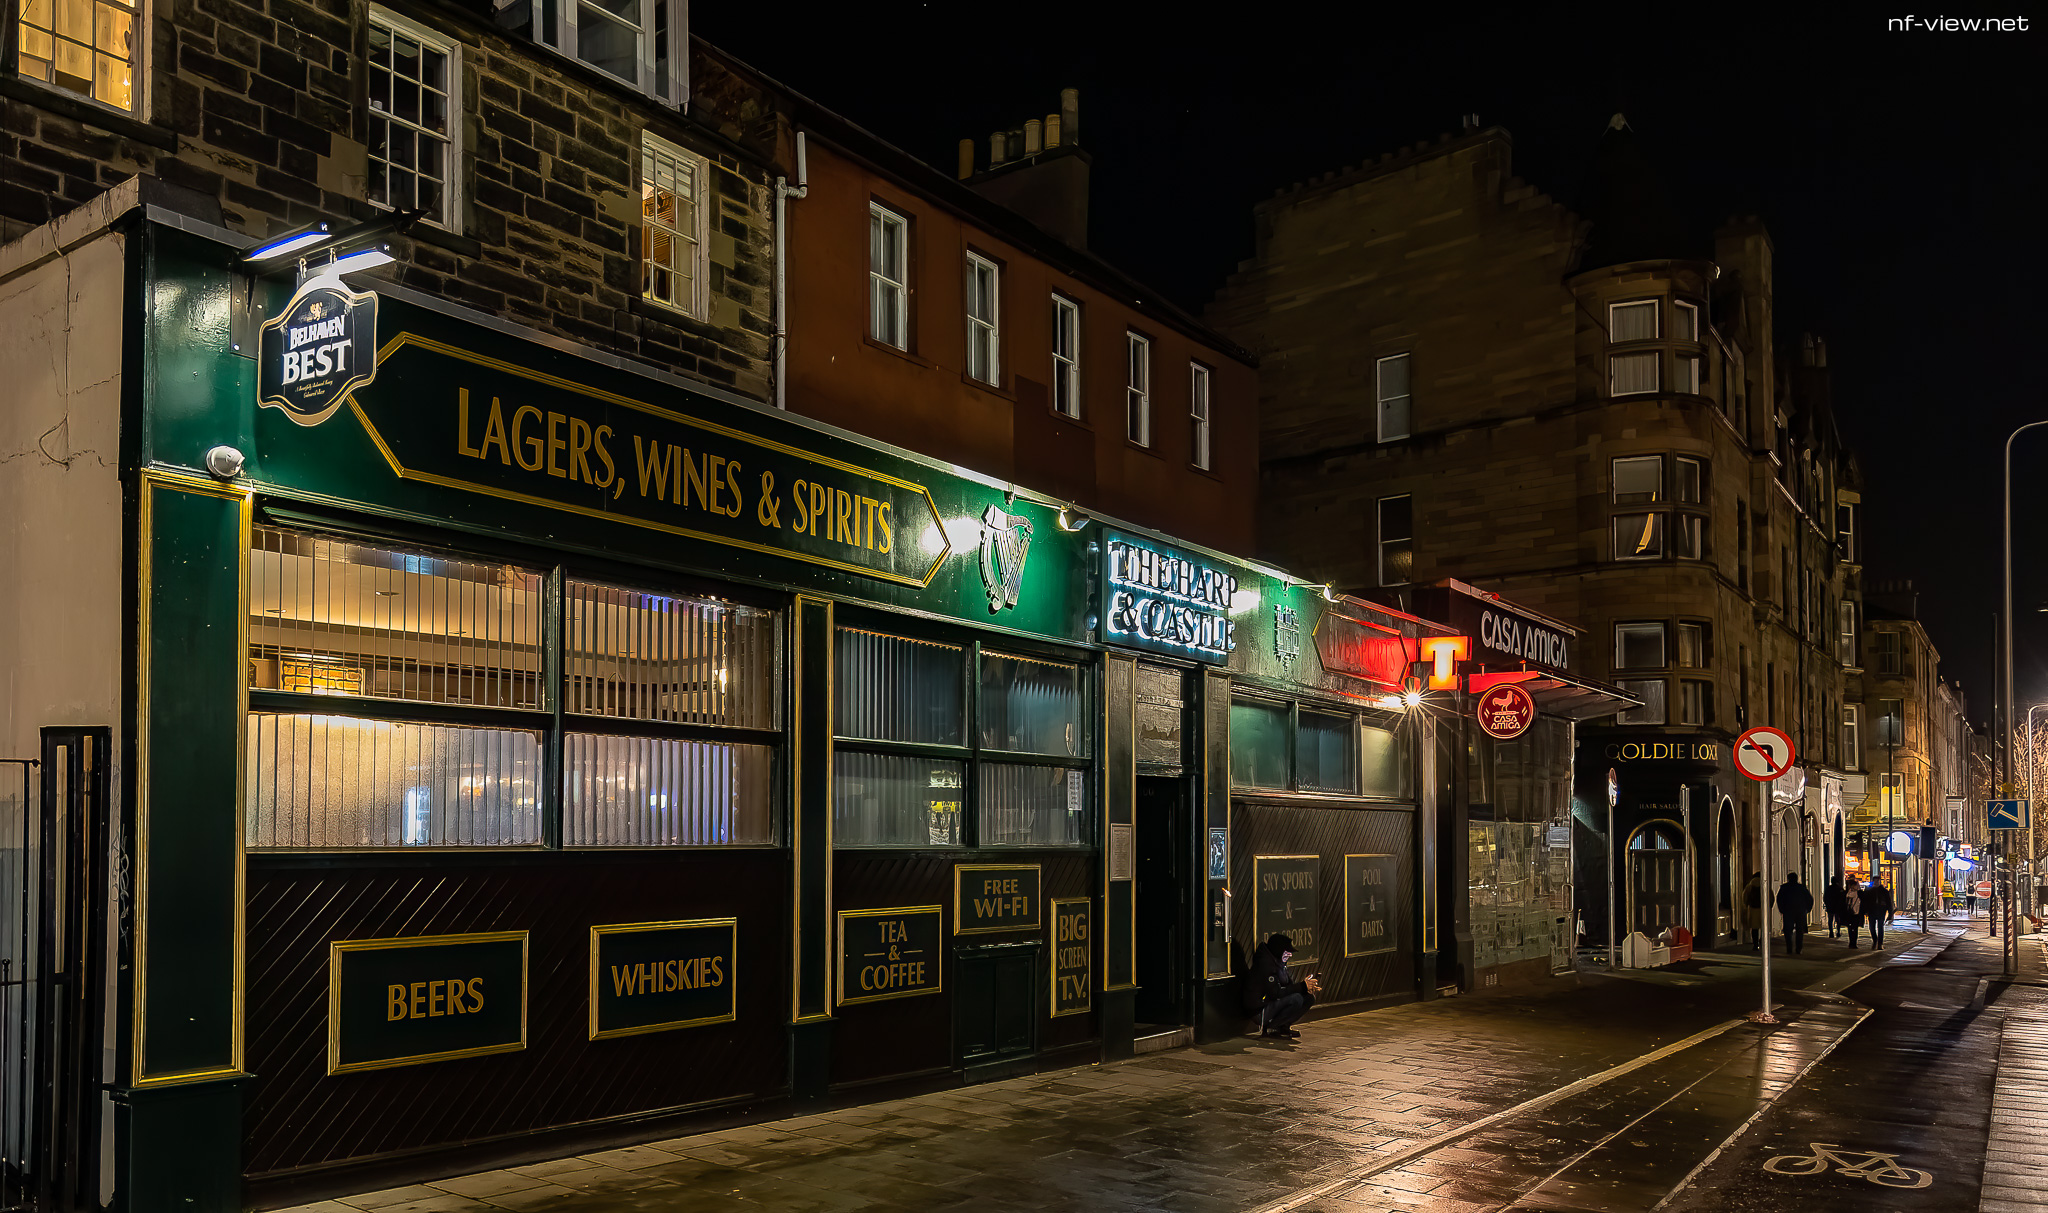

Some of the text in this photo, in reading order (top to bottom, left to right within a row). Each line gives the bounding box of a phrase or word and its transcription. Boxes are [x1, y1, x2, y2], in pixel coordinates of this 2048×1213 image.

[290, 315, 345, 350] BELHAVEN
[282, 339, 352, 385] BEST
[458, 387, 892, 554] LAGERS, WINES & SPIRITS
[1107, 541, 1238, 608] THE HARP
[1108, 592, 1236, 654] & CASTLE
[1481, 610, 1568, 669] CASA AMIGA
[1491, 721, 1520, 730] AMIGA
[1494, 715, 1517, 723] CASA
[1605, 743, 1685, 762] GOLDIE
[984, 879, 1018, 895] FREE
[1263, 872, 1313, 891] SKY SPORTS
[1363, 869, 1381, 886] POOL
[974, 897, 1028, 918] WI-FI
[1286, 901, 1293, 919] &
[1370, 895, 1375, 912] &
[878, 921, 908, 943] TEA
[1059, 913, 1086, 942] BIG
[1362, 920, 1383, 938] DARTS
[888, 945, 900, 960] &
[1059, 946, 1087, 970] SCREEN
[611, 956, 723, 997] WHISKIES
[861, 961, 925, 991] COFFEE
[1058, 974, 1087, 1001] T.V.
[388, 977, 484, 1022] BEERS
